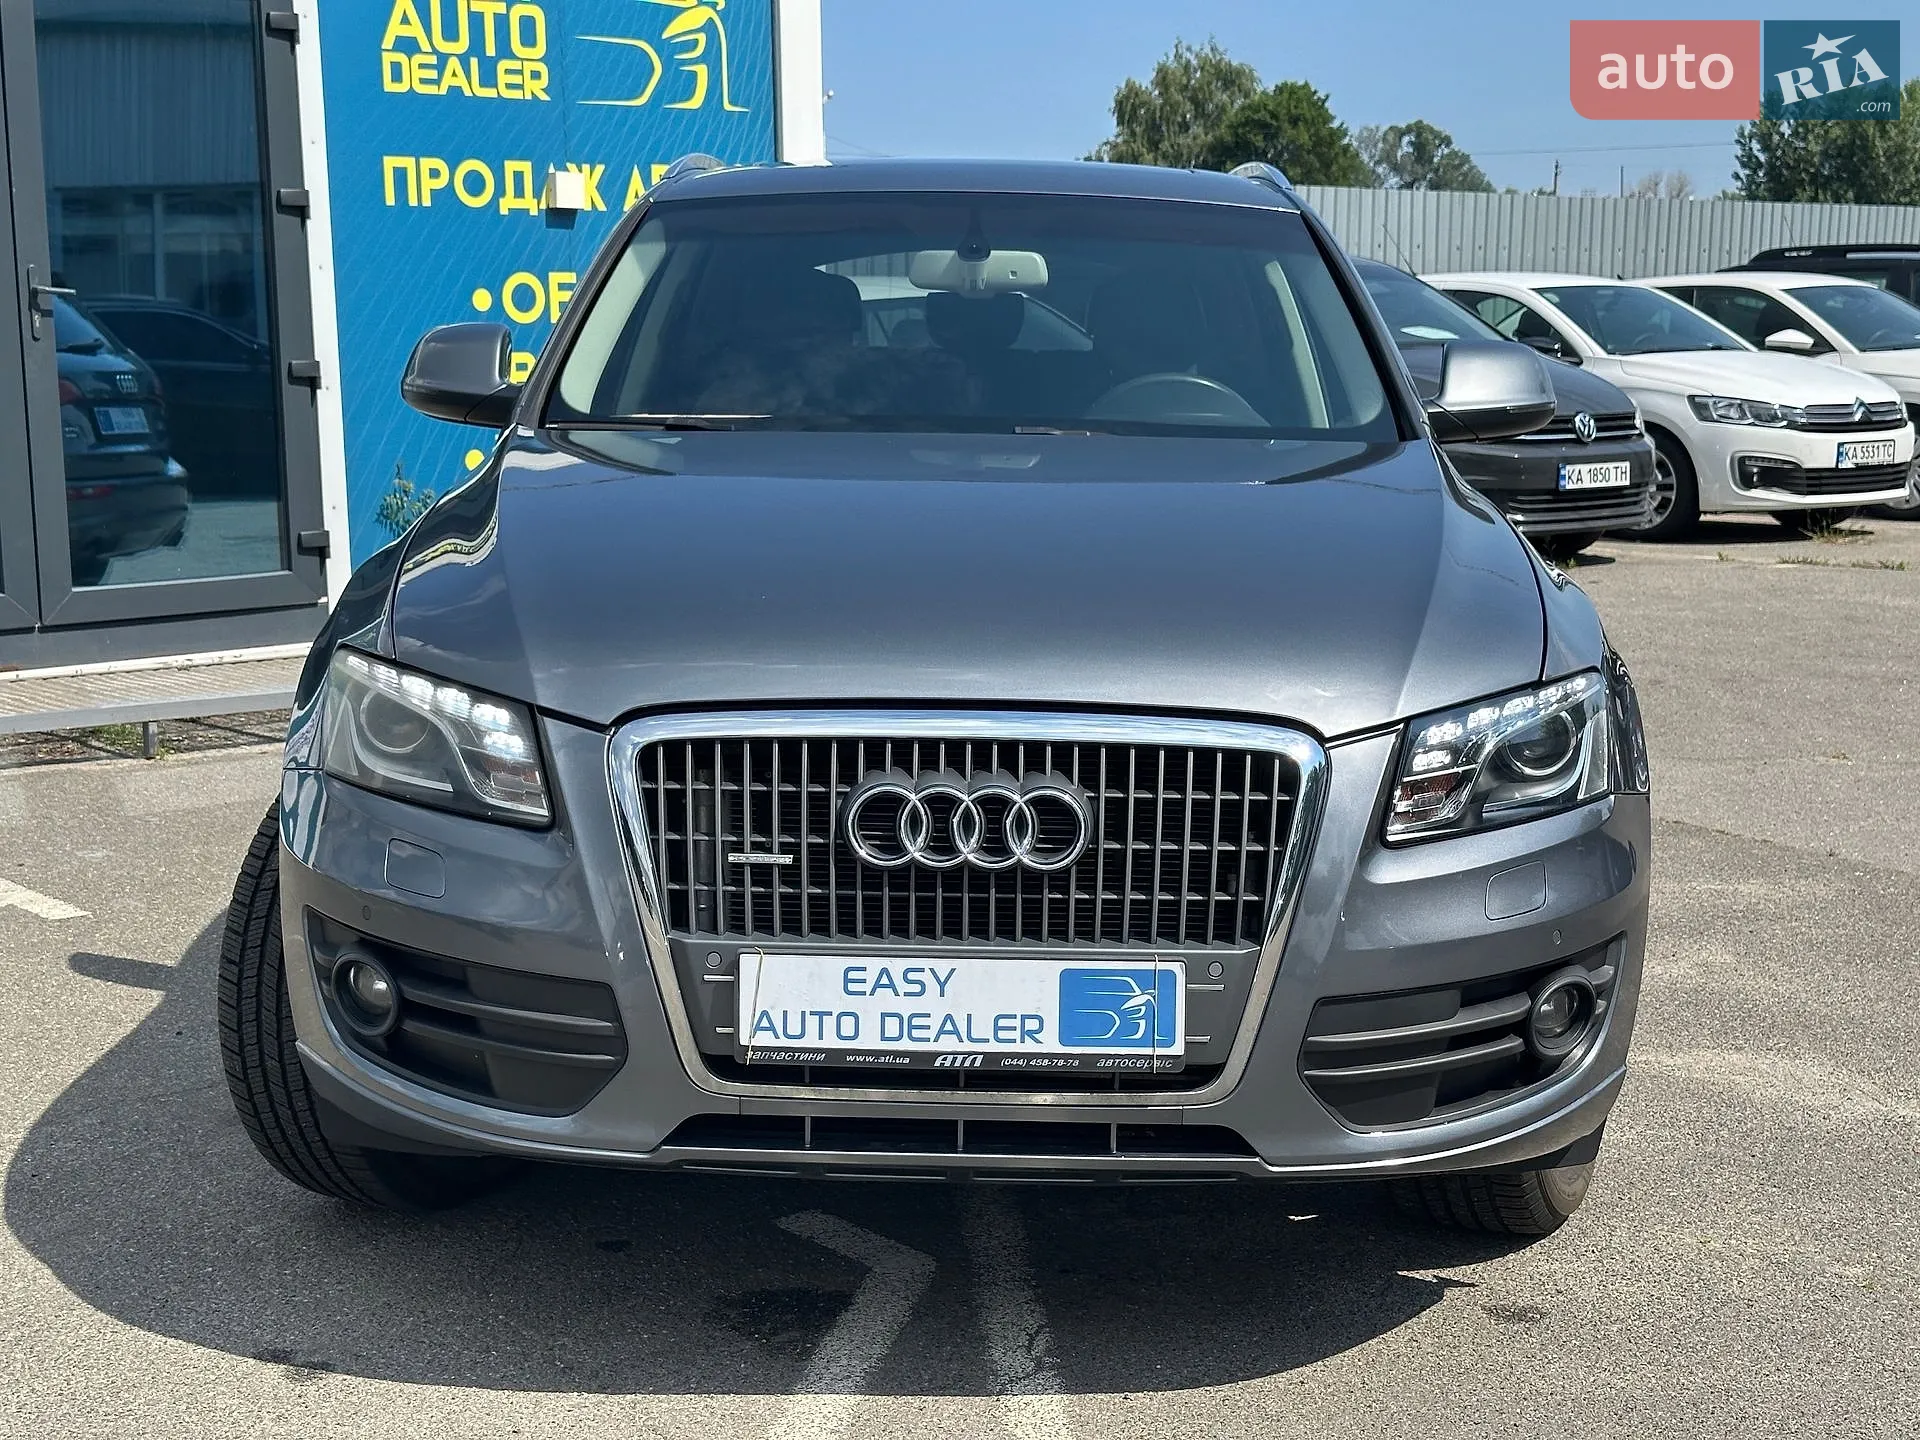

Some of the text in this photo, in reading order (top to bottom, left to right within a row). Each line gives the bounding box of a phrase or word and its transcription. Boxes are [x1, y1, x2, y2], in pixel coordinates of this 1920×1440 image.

[381, 0, 548, 60] AUTO
[382, 51, 551, 101] DEALER
[1844, 444, 1893, 461] KA 5531 TC
[1567, 468, 1584, 485] KA
[1588, 467, 1610, 484] 1850
[1613, 465, 1628, 482] TH
[843, 966, 957, 998] EASY
[753, 1009, 1044, 1044] AUTO DEALER
[744, 1050, 827, 1062] запчастини
[846, 1053, 910, 1064] www.atl.ua
[1000, 1058, 1028, 1068] (044)
